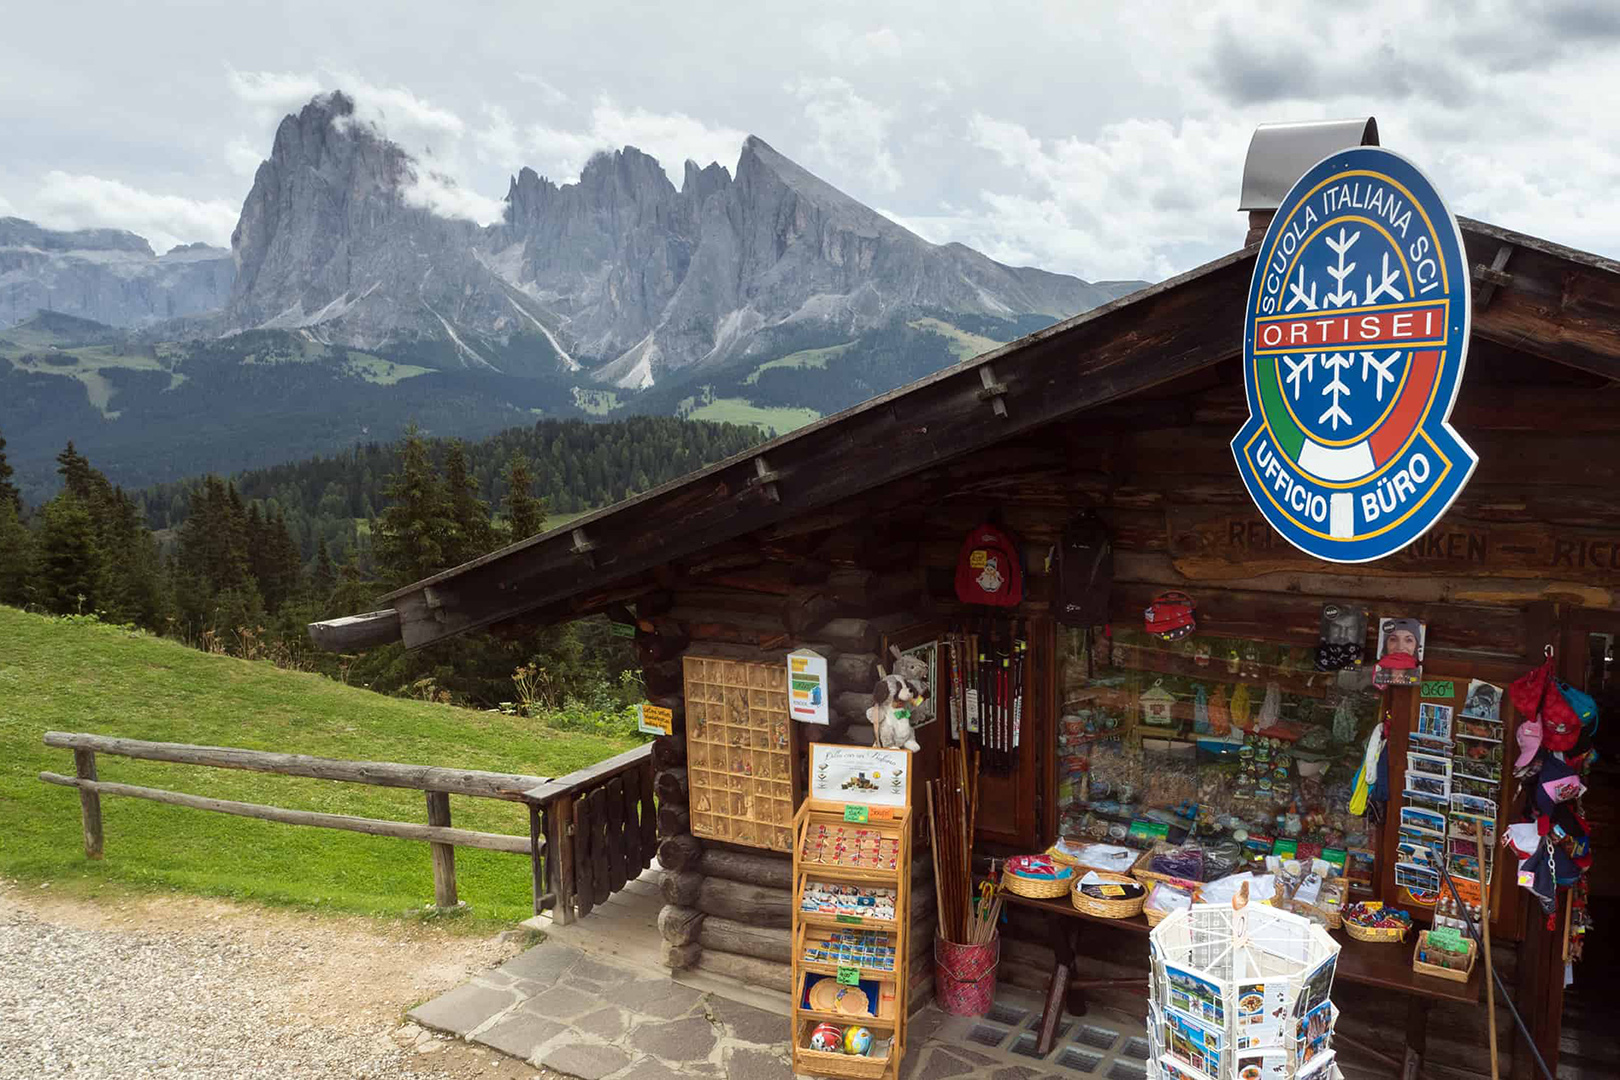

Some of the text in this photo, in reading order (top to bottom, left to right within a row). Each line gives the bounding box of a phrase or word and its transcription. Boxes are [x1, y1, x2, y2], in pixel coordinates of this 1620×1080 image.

[1262, 183, 1439, 315] SCUOLA ITALIANA SCI
[1262, 312, 1433, 347] ORTISEI
[1256, 439, 1430, 523] UFFICIO BÜRO
